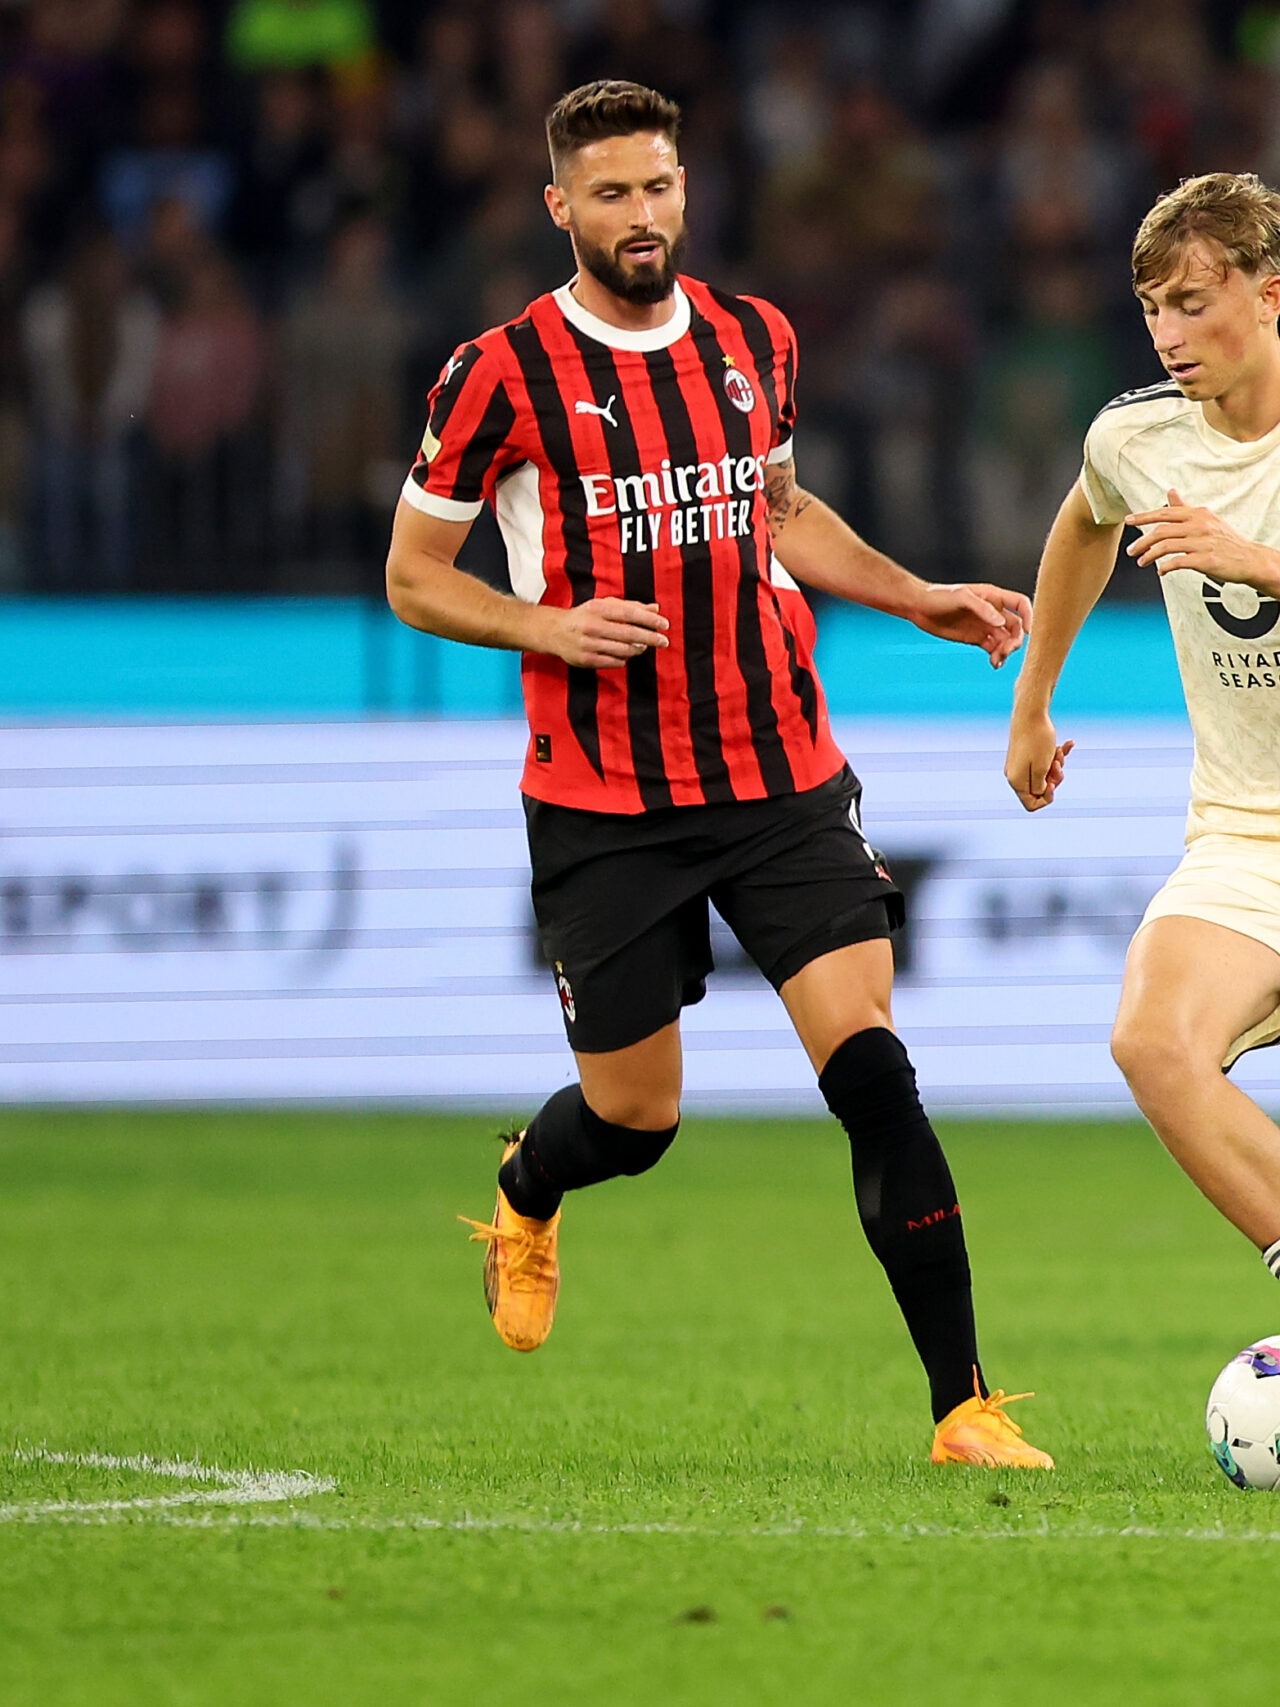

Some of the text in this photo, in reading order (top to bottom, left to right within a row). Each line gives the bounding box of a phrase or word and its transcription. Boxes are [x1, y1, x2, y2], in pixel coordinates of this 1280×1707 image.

[578, 452, 766, 518] Emirates
[620, 499, 751, 554] FLY BETTER
